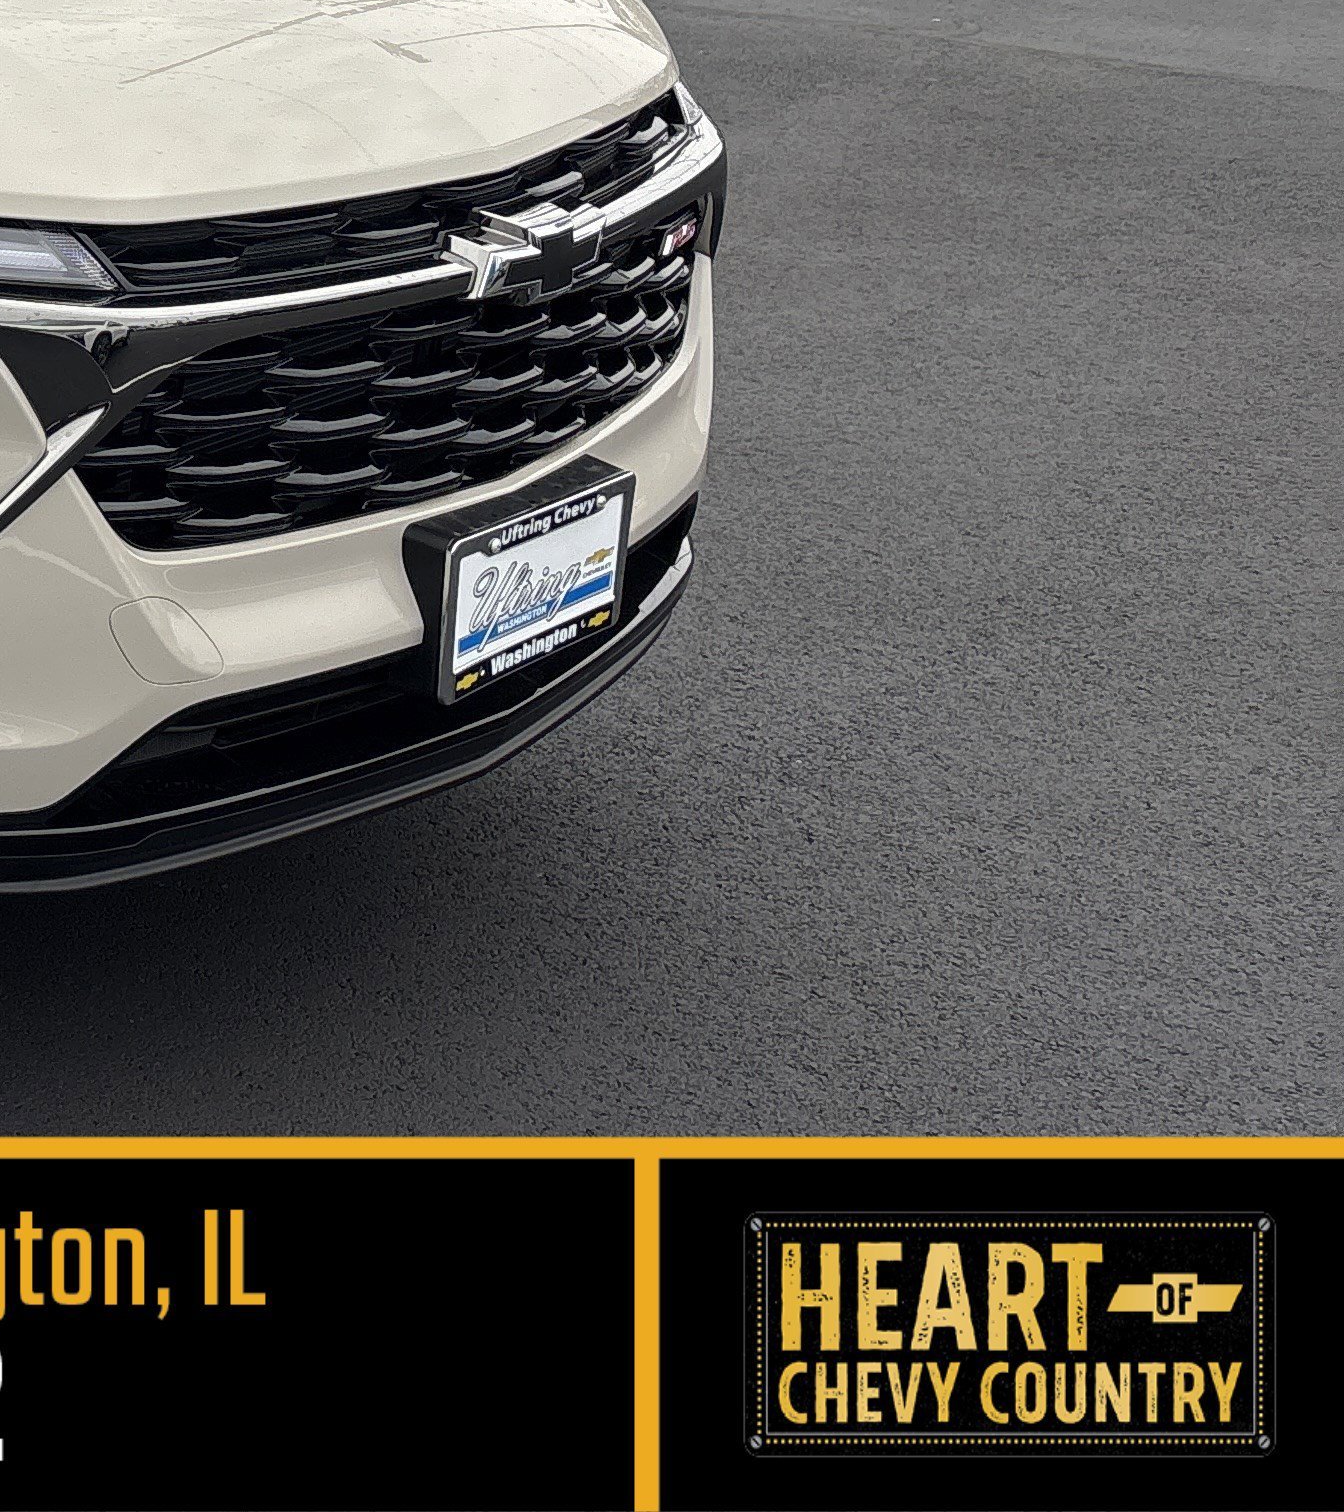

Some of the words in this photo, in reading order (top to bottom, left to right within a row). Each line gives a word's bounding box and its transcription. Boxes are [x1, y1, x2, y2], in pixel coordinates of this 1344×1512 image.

[502, 517, 551, 545] Uftring
[554, 498, 596, 525] Chevy
[469, 561, 582, 652] Uftring
[497, 604, 548, 634] WASHINGTON
[491, 624, 578, 675] Washington
